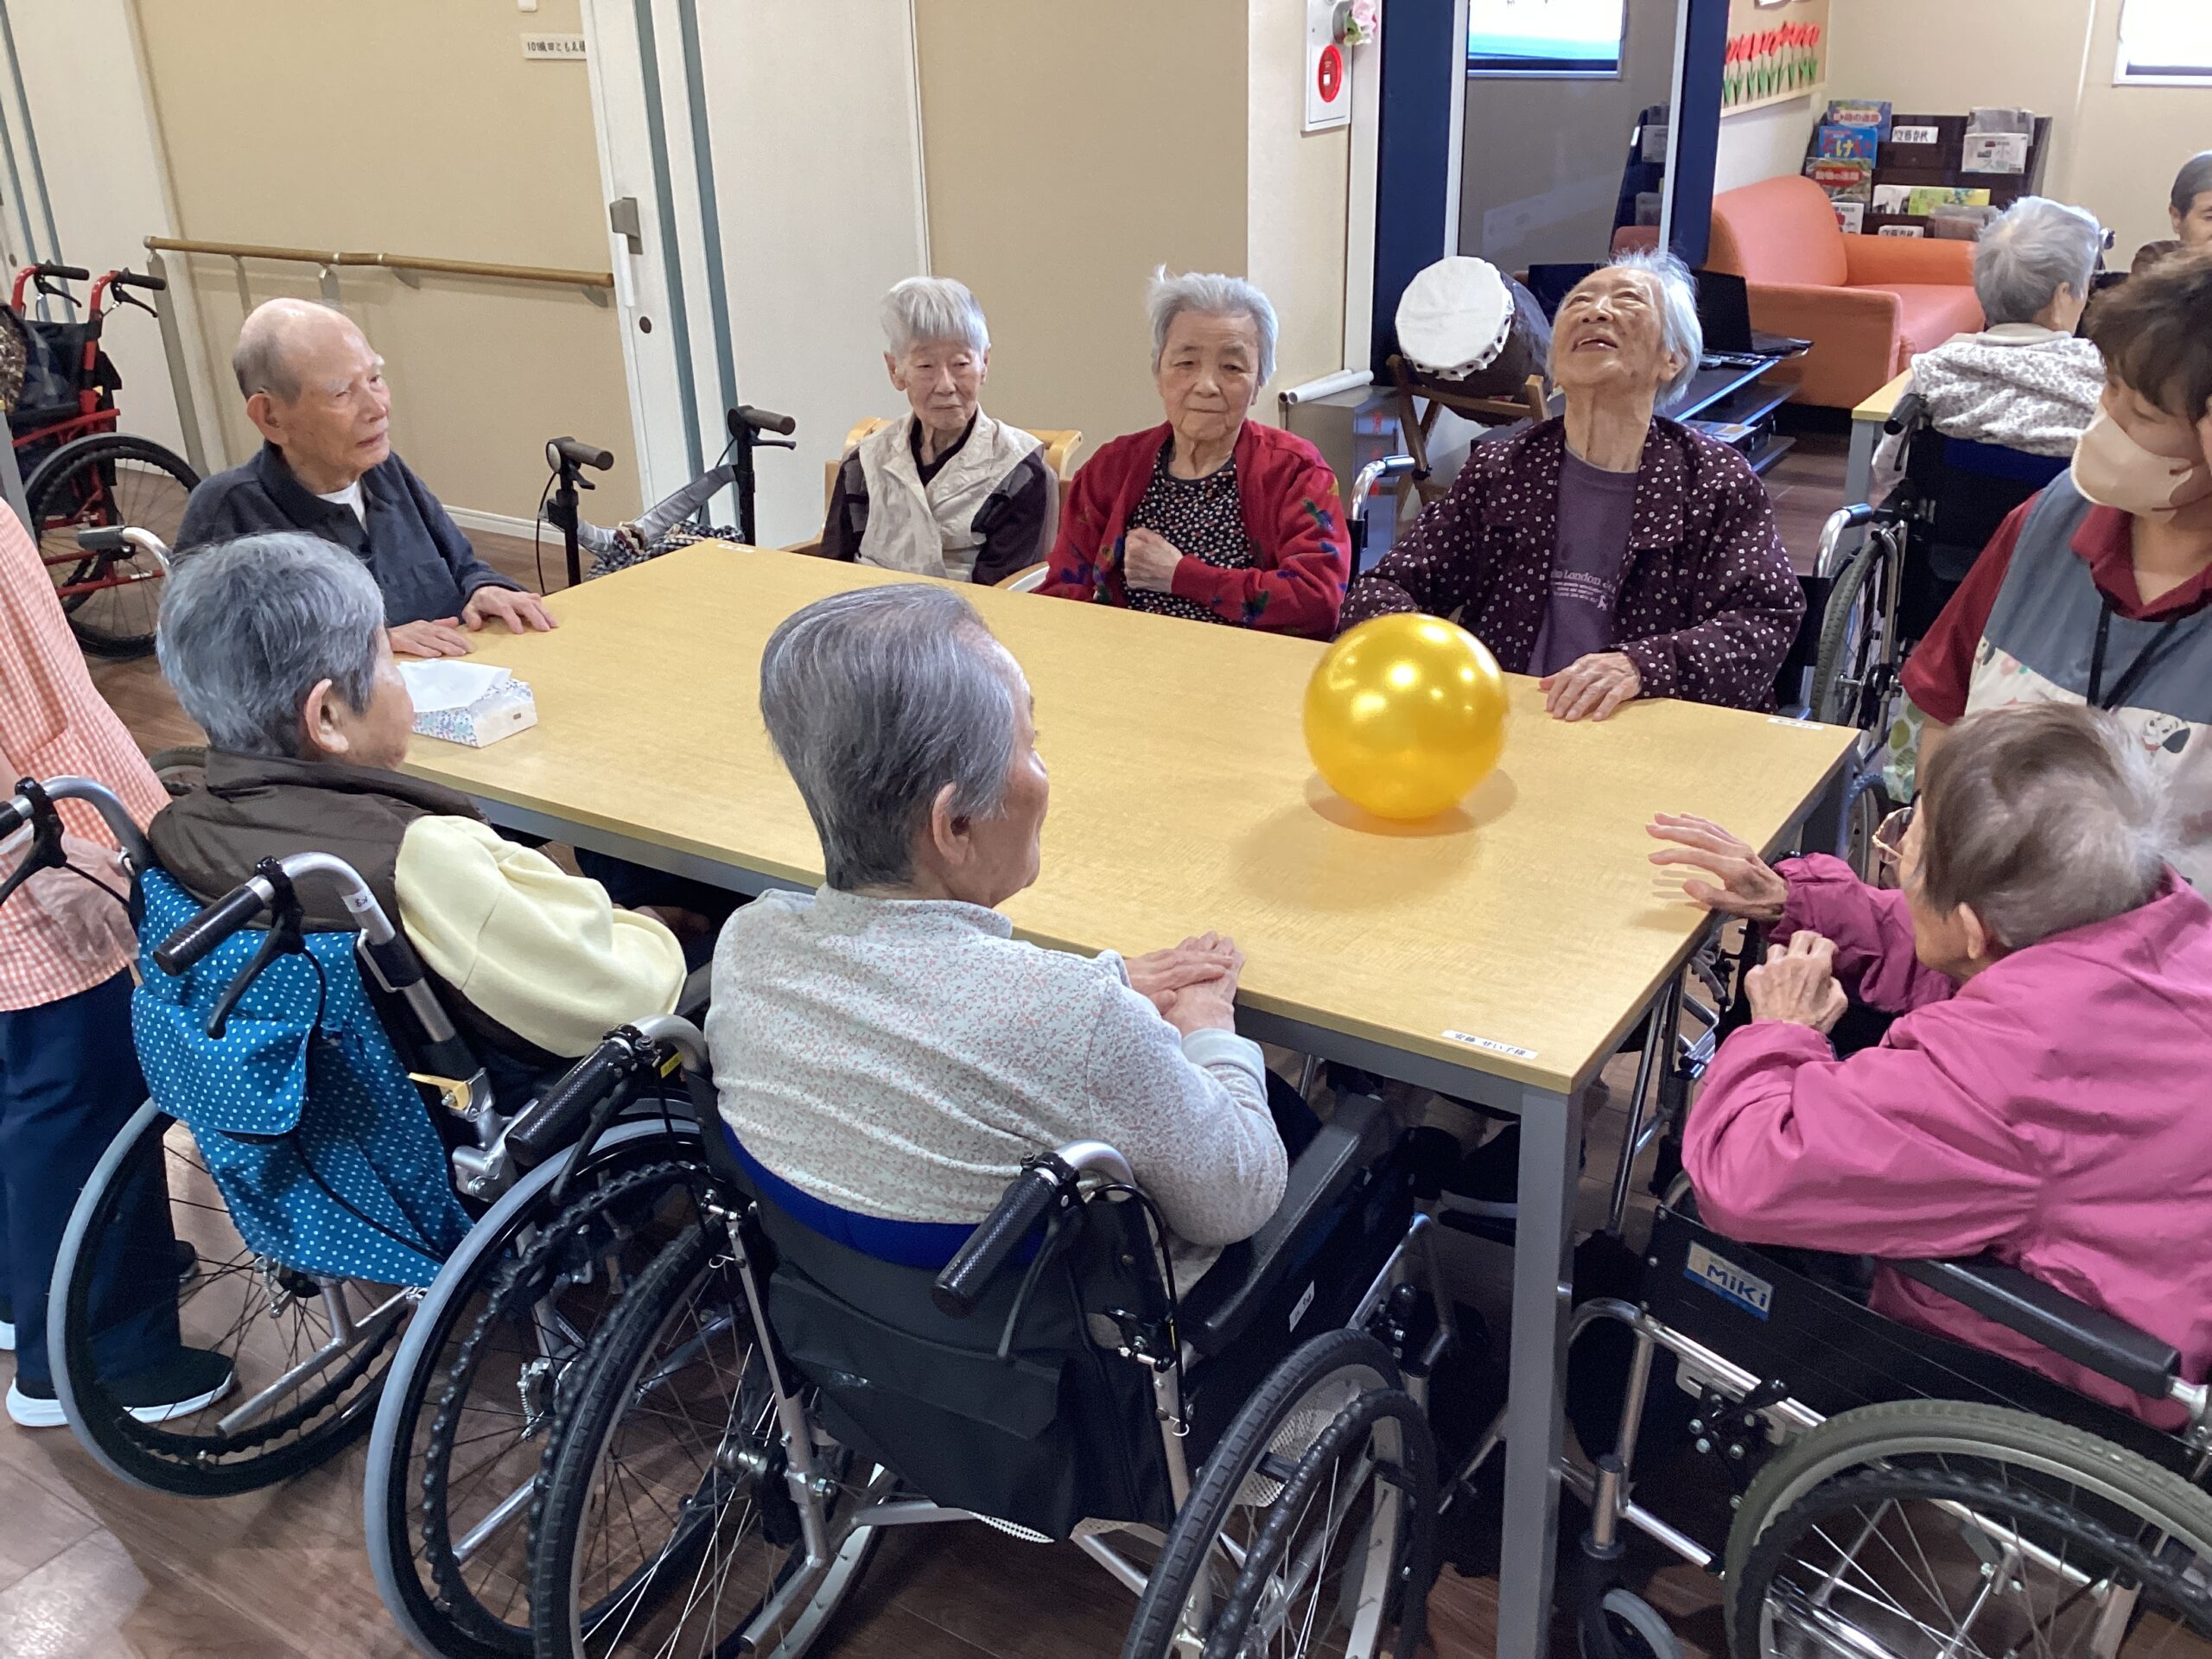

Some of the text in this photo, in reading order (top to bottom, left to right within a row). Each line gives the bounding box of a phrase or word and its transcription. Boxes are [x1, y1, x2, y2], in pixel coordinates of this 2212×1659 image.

[1822, 137, 1872, 157] とけい
[1563, 569, 1602, 586] London
